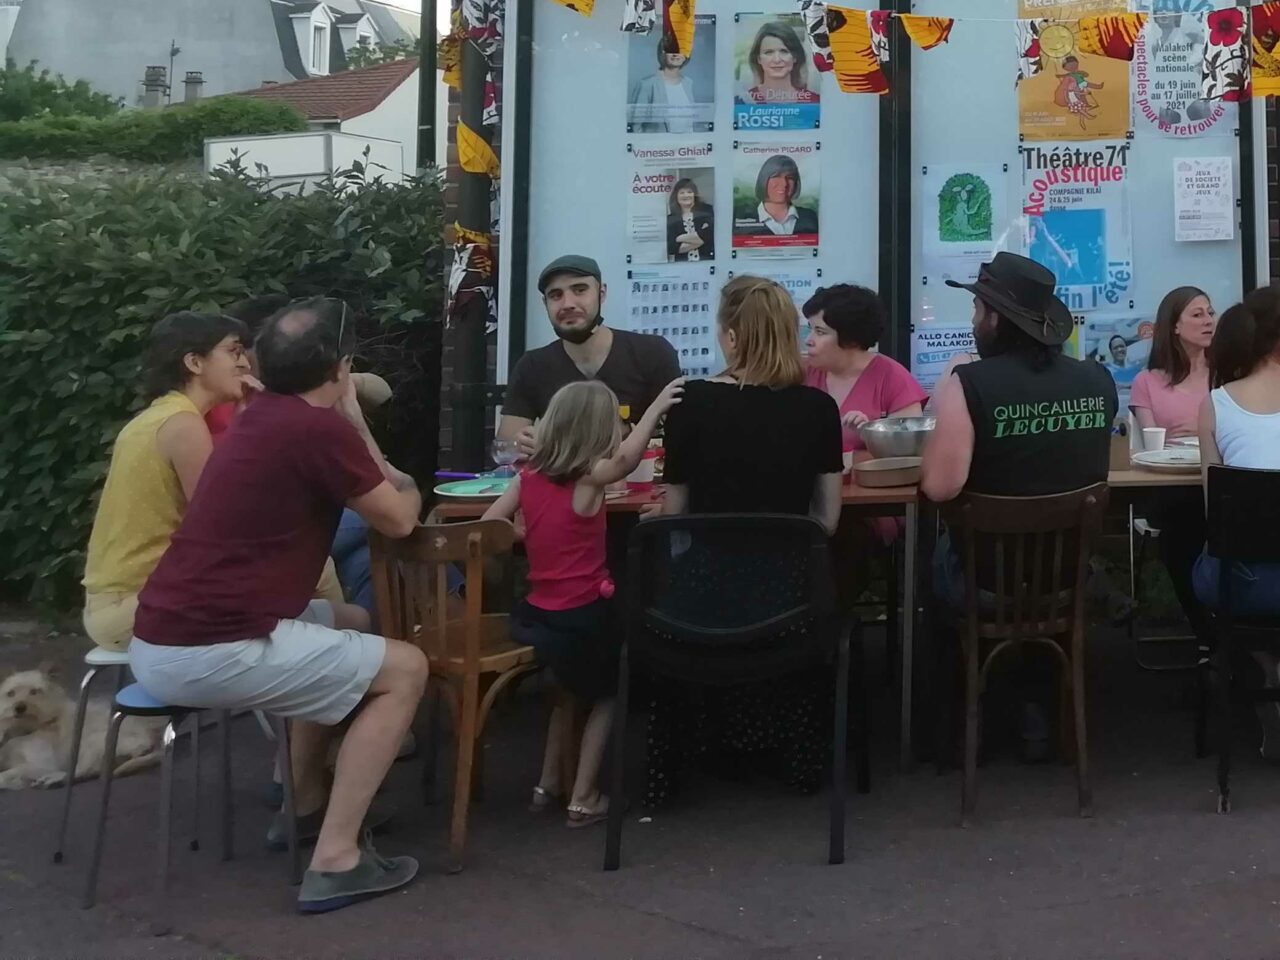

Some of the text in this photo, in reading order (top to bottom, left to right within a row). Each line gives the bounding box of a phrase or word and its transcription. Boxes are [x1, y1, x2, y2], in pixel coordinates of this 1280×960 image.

[1157, 42, 1193, 52] Malakoff
[1162, 53, 1187, 63] scène
[1136, 34, 1149, 96] spectacles
[1155, 63, 1194, 73] nationale
[1154, 79, 1196, 91] du 19 juin
[1150, 89, 1201, 101] au 17 juillet
[750, 106, 800, 116] Laurianne
[1136, 98, 1159, 124] pour
[1166, 100, 1186, 111] 2021
[1174, 103, 1226, 136] retrouver
[632, 148, 675, 158] Vanessa
[644, 174, 675, 183] votre
[632, 183, 672, 194] écoute
[1023, 162, 1123, 217] Acoustique
[926, 340, 977, 348] MALAKOF
[993, 397, 1104, 420] QUINCAILLERIE
